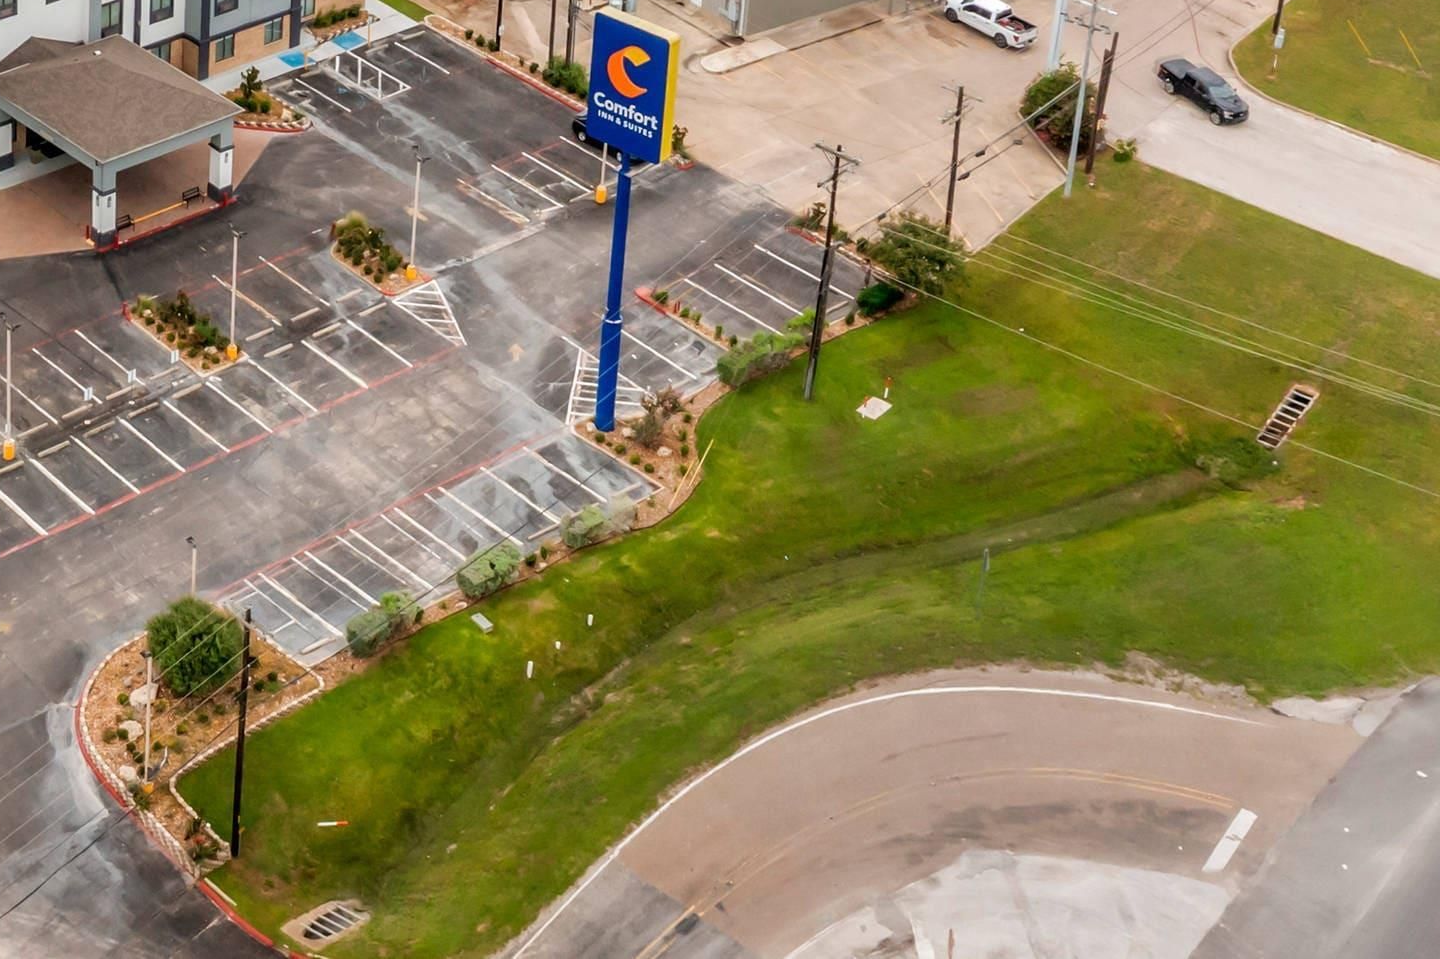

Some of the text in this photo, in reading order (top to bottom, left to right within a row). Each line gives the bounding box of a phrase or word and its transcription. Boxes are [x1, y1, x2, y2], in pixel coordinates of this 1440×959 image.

[593, 91, 658, 130] Comfort
[597, 109, 653, 139] INN & SUITES
